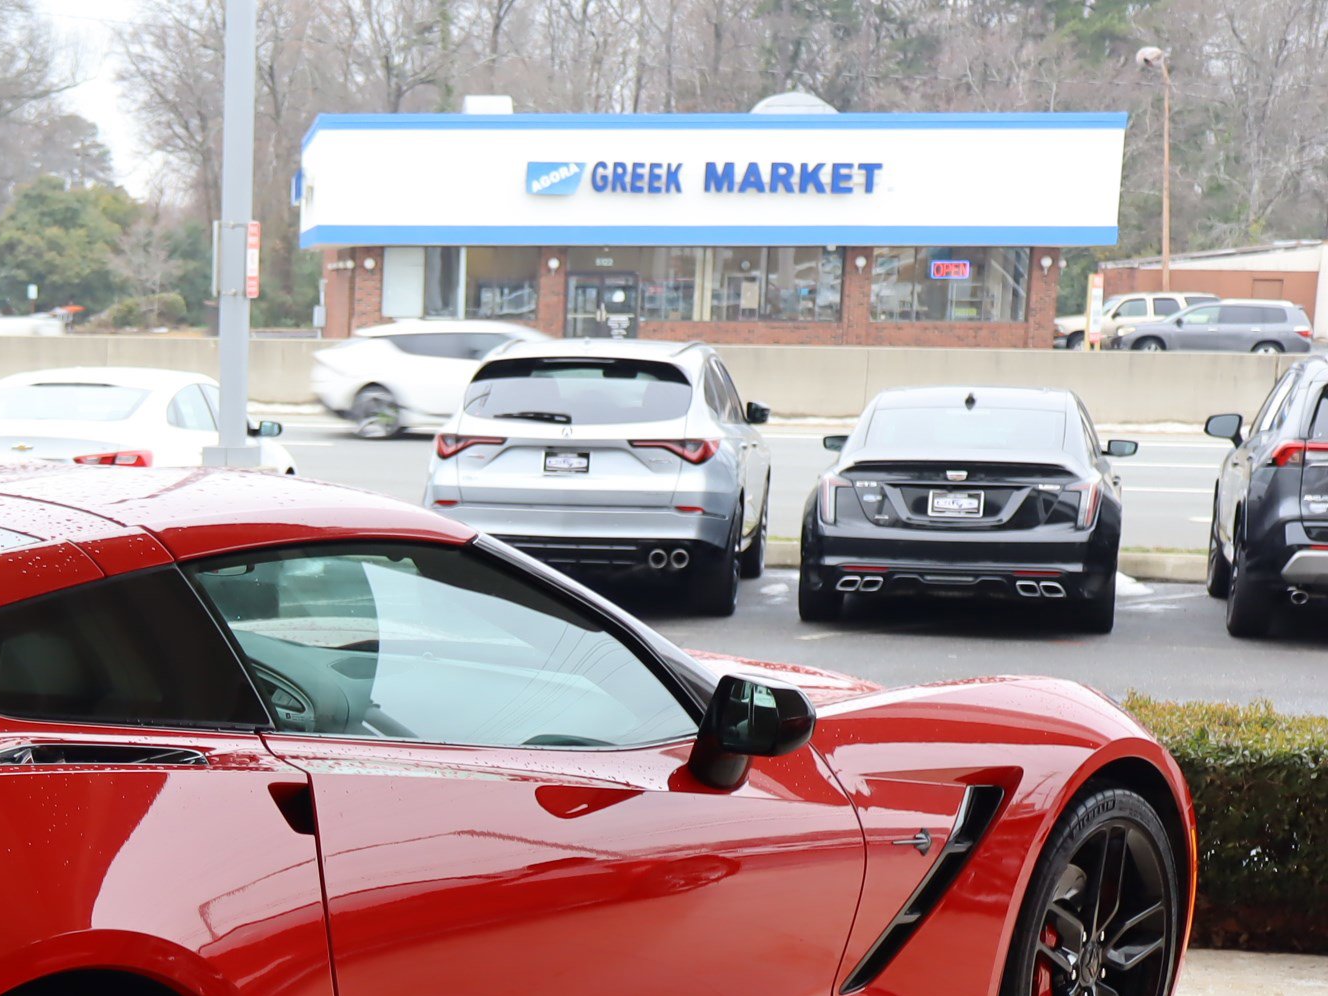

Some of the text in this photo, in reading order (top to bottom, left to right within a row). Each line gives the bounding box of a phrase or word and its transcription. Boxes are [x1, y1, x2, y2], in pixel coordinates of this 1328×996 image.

[531, 163, 580, 193] AGORA
[591, 161, 883, 194] GREEK MARKET
[932, 262, 969, 278] OPEN
